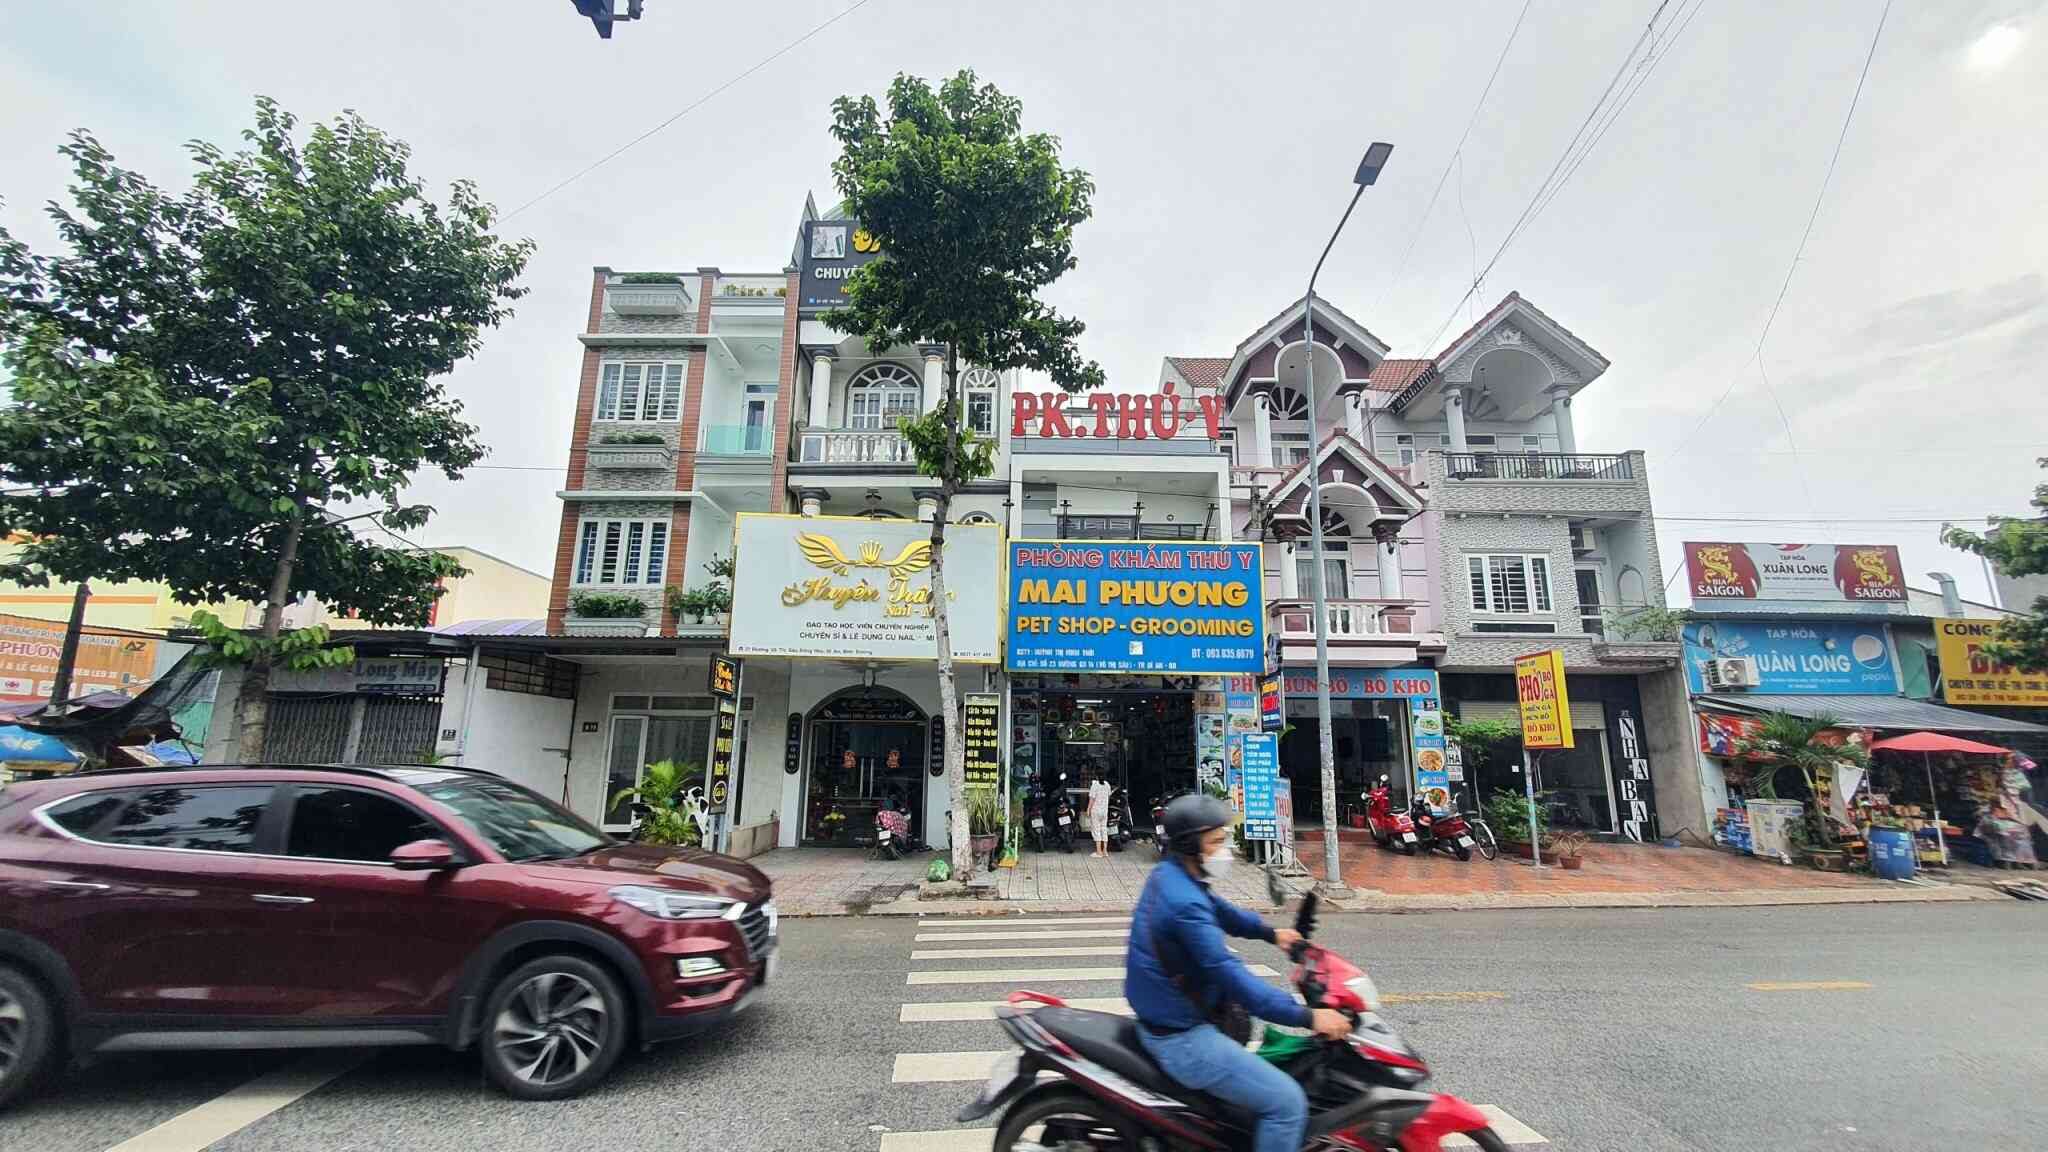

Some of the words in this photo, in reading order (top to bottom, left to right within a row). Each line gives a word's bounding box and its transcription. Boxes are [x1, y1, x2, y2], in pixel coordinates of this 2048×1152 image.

[1109, 545, 1180, 569] KHÁM
[1187, 545, 1231, 569] THÚ
[1238, 552, 1253, 569] Y
[1763, 561, 1794, 574] XUÂN
[1796, 565, 1828, 574] LONG
[1019, 579, 1087, 604] MAI
[1100, 580, 1249, 607] PHƯƠNG
[1697, 585, 1744, 596] SAIGON
[1854, 588, 1901, 598] SAIGON
[1017, 617, 1052, 633] PET
[1058, 617, 1116, 635] SHOP
[1130, 619, 1254, 636] GROOMING
[125, 640, 146, 651] AZ
[1801, 655, 1851, 672] LONG
[1391, 679, 1432, 694] KHO
